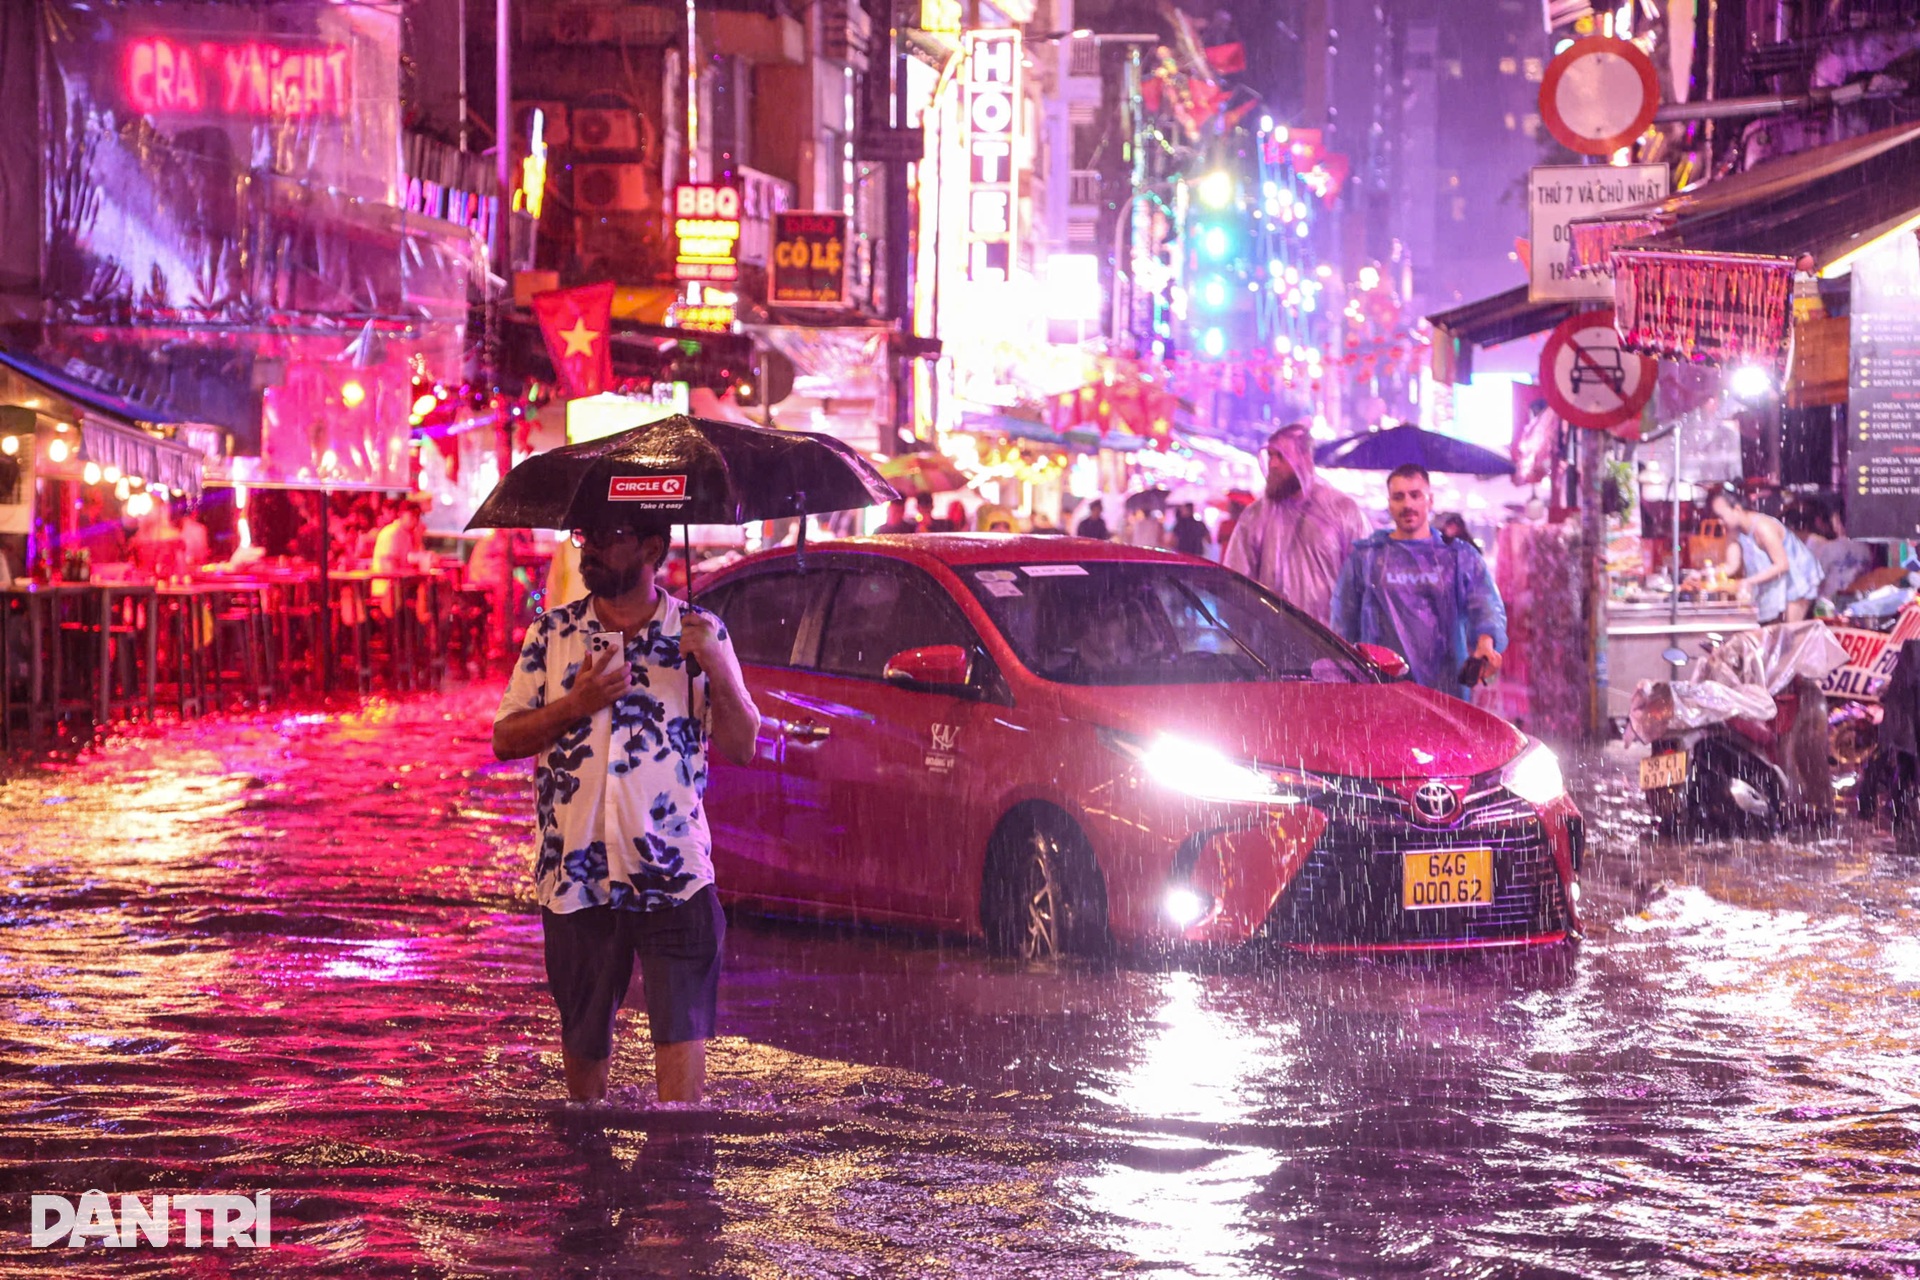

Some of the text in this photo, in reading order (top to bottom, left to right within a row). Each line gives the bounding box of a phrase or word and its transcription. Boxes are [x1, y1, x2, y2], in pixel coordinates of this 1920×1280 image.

[971, 41, 1012, 281] HOTEL
[676, 185, 739, 219] BBQ
[1566, 186, 1573, 204] 7
[615, 479, 680, 493] CIRCLE K
[665, 503, 683, 511] easy
[1429, 853, 1466, 877] 64G
[1413, 879, 1483, 905] 000.62
